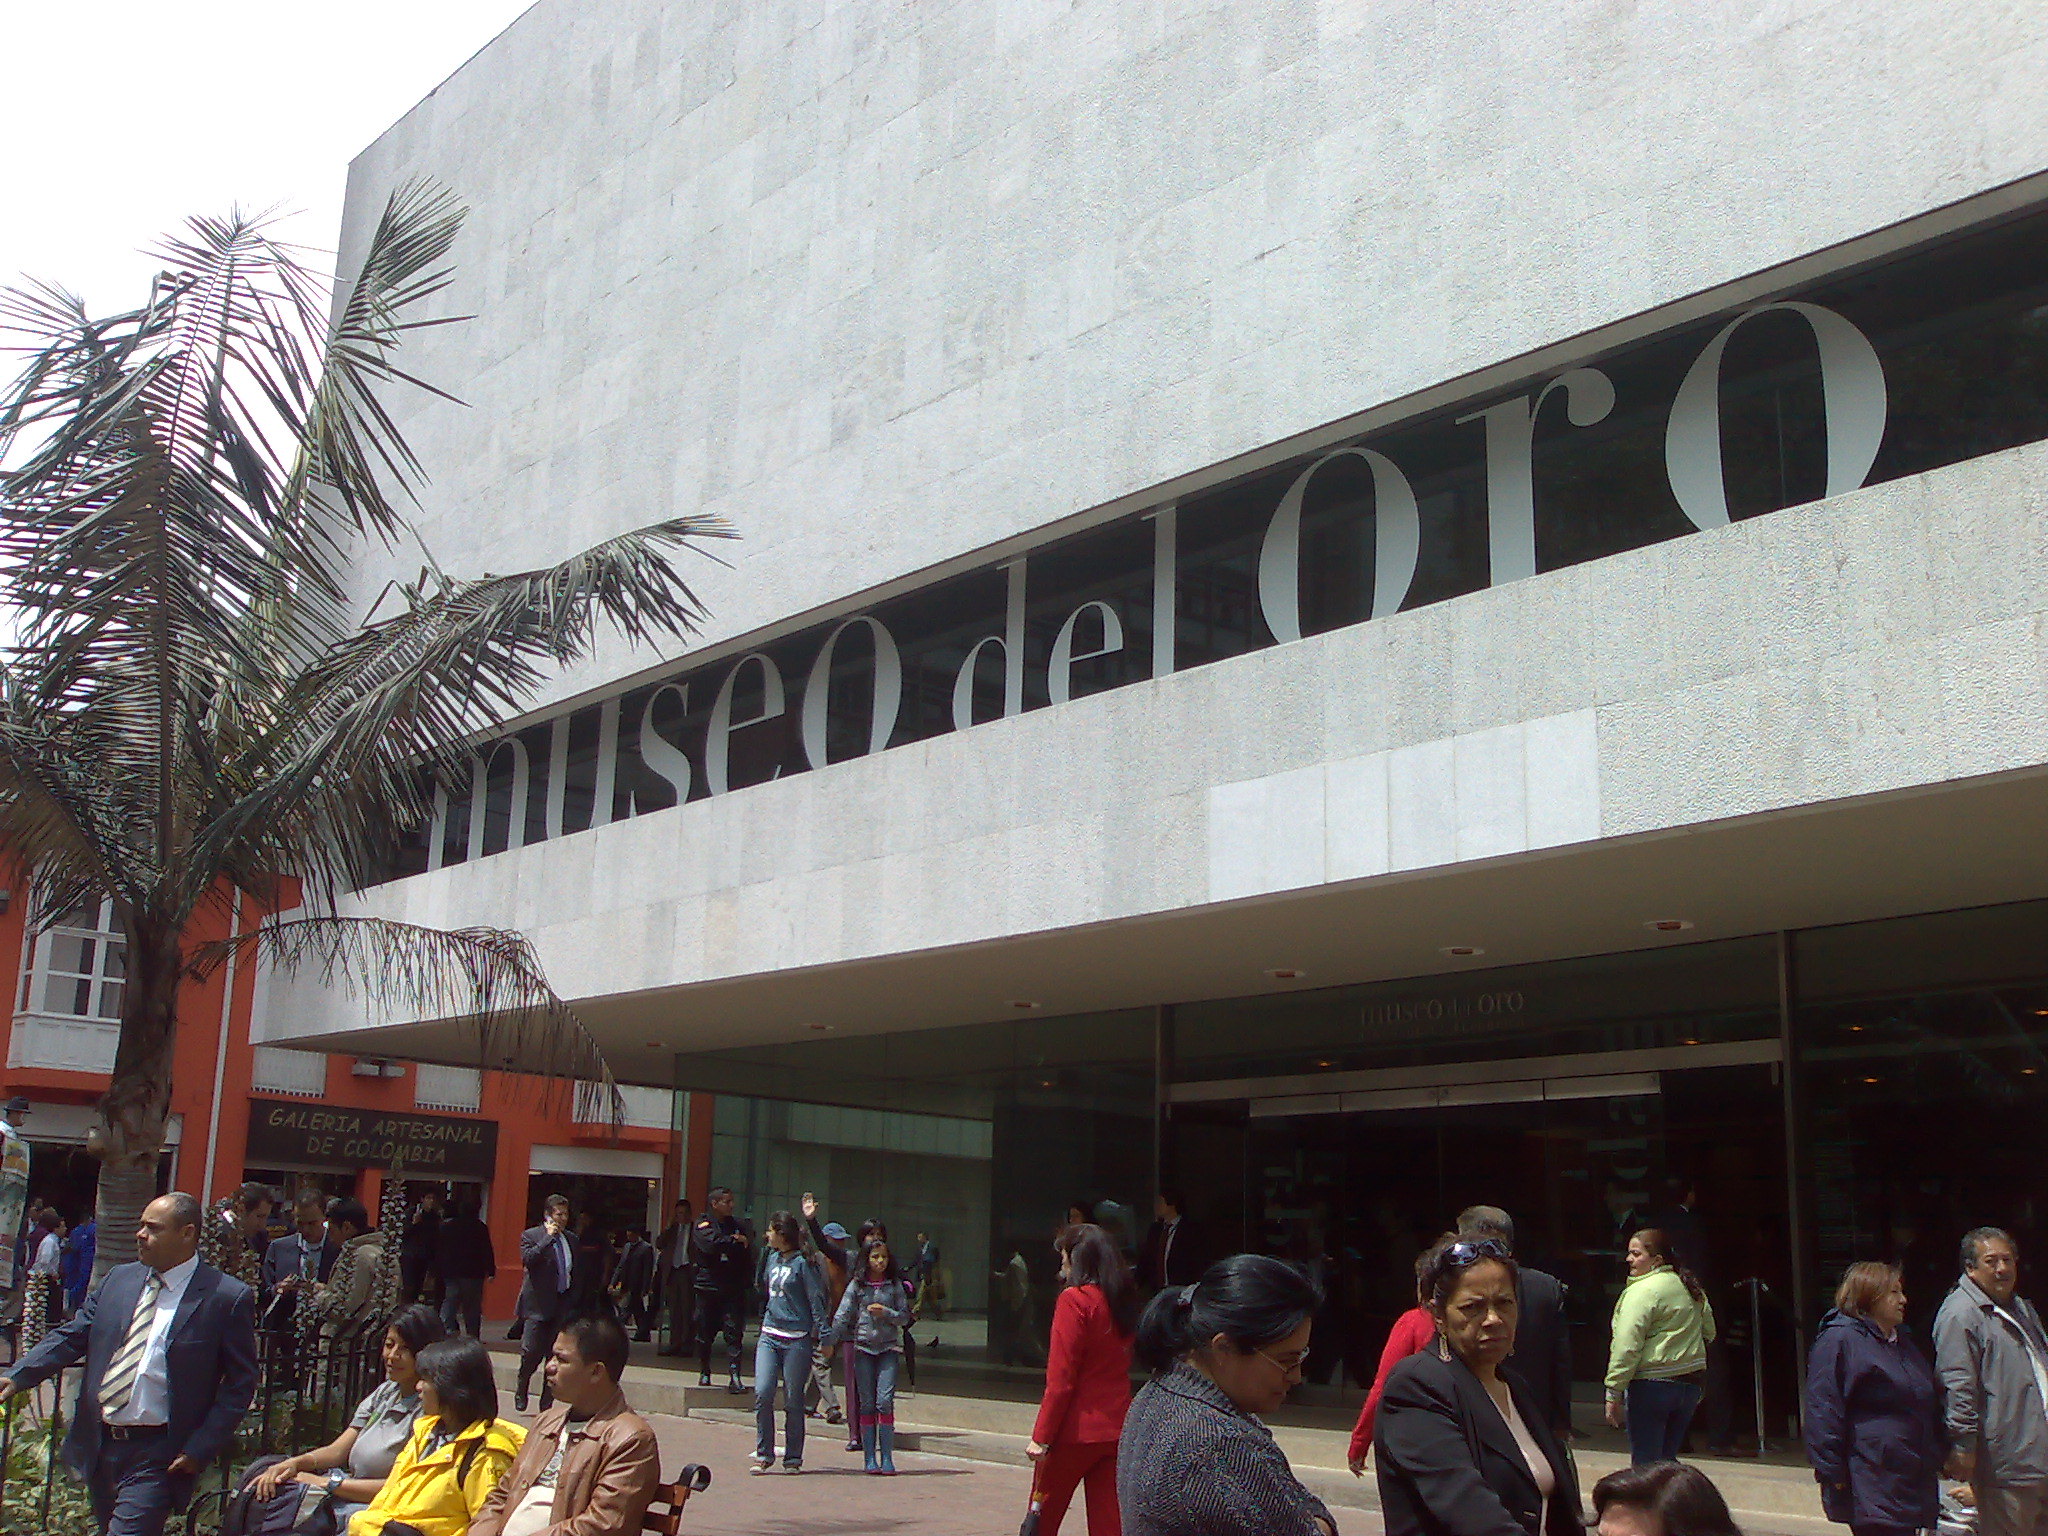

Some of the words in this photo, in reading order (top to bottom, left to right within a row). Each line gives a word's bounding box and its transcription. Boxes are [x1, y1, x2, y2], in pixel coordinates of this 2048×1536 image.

[951, 506, 1177, 731] del
[1257, 299, 1889, 649] oro
[268, 1107, 362, 1135] GALERIA
[371, 1118, 484, 1145] ARTESANAL
[306, 1135, 336, 1156] DE
[768, 1265, 792, 1298] 27
